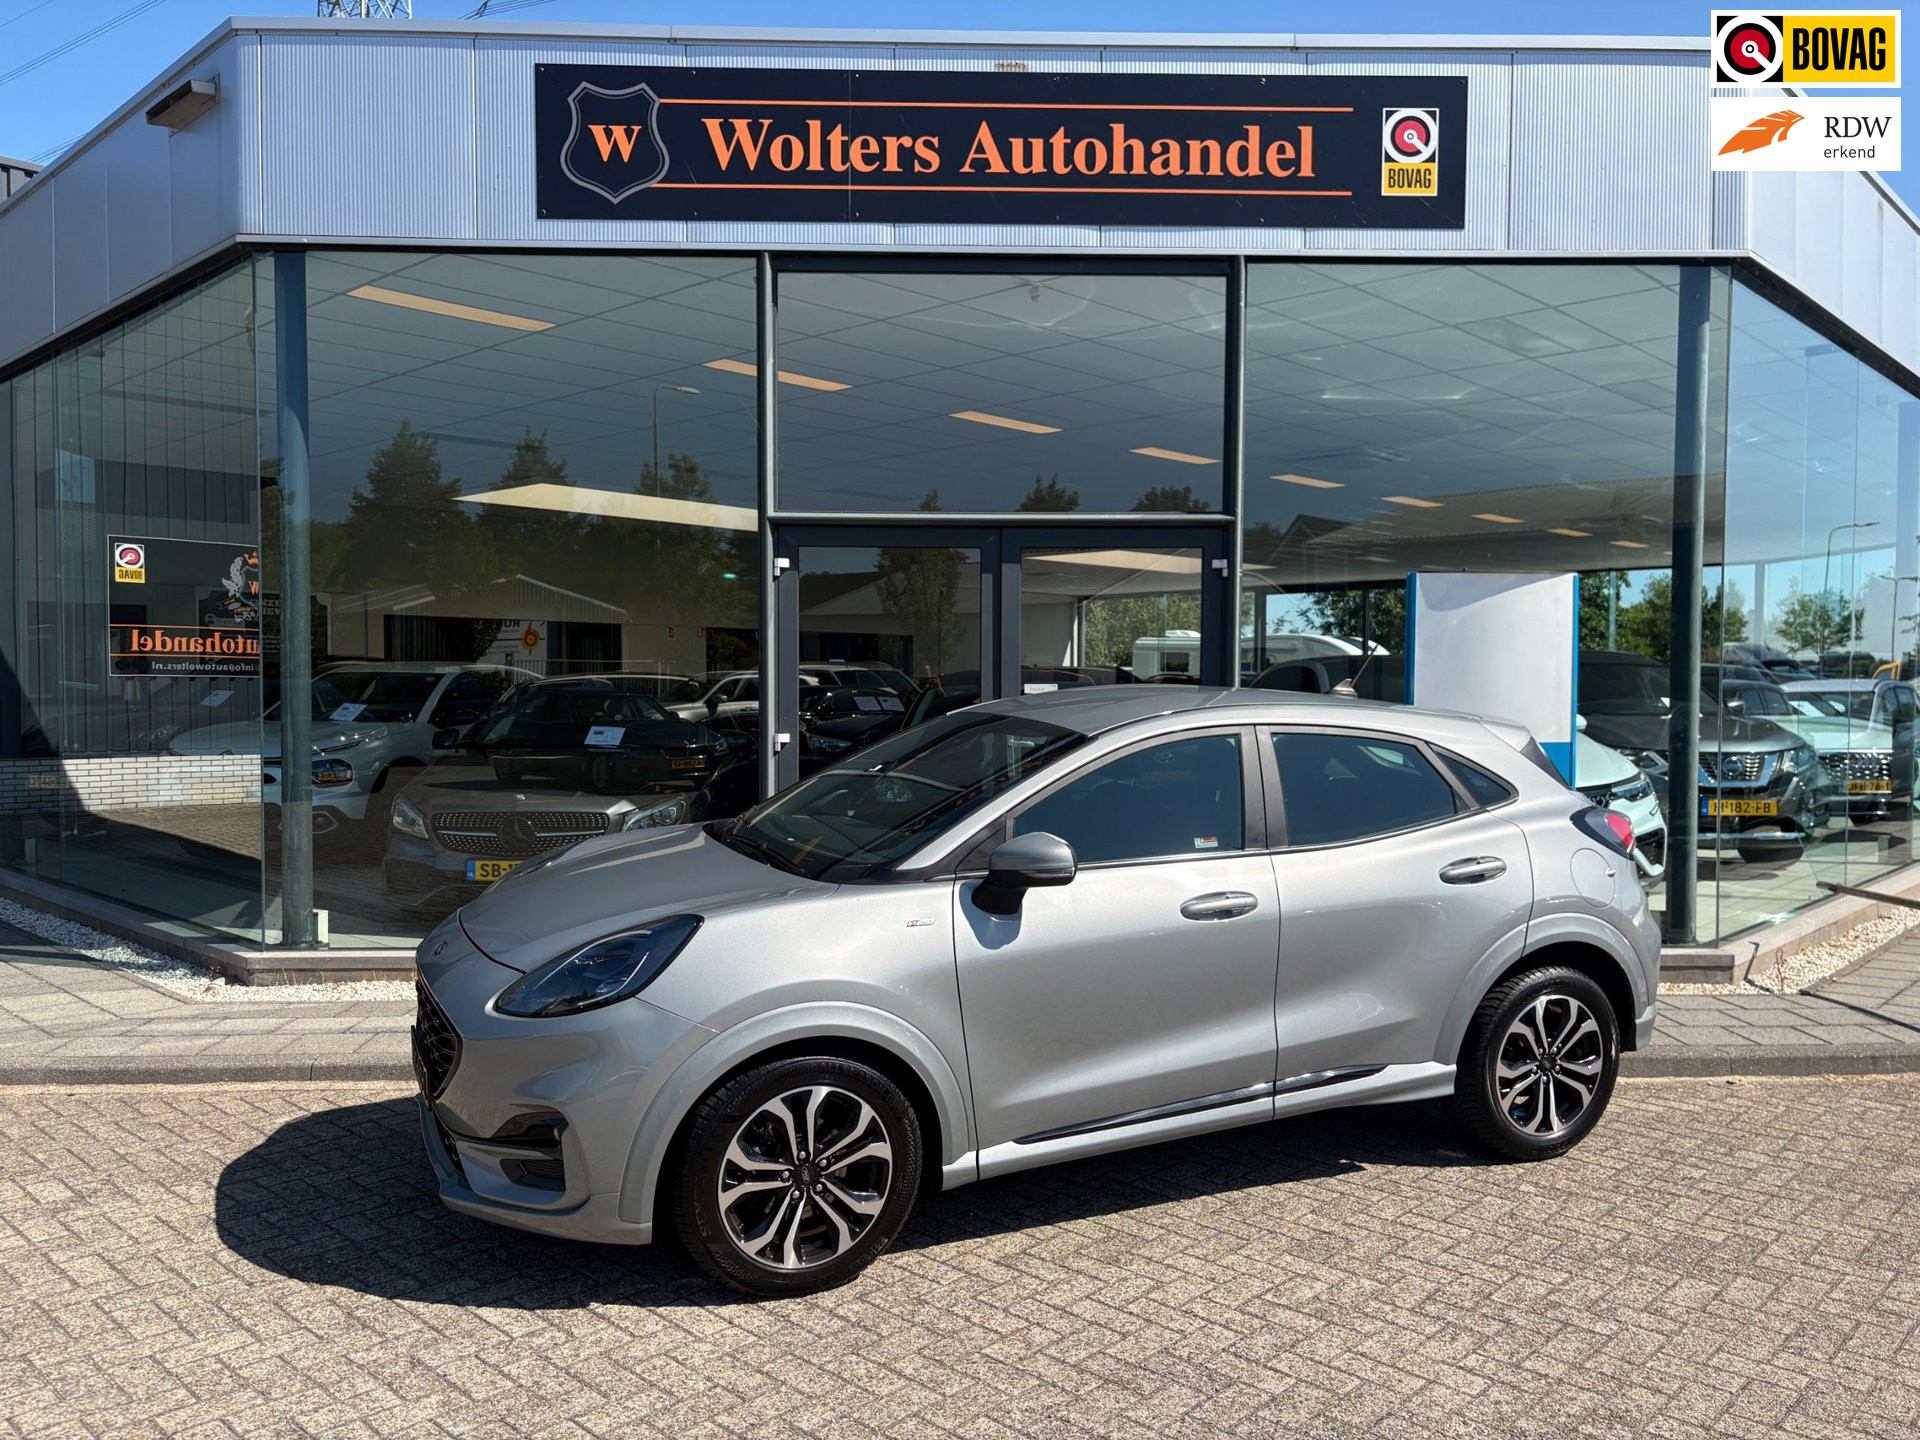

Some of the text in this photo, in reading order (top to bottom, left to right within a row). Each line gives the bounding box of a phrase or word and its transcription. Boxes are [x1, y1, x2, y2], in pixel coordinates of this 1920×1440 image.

[588, 125, 642, 162] W
[701, 118, 1315, 177] Wolters Autohandel
[1388, 168, 1432, 189] BOVAG
